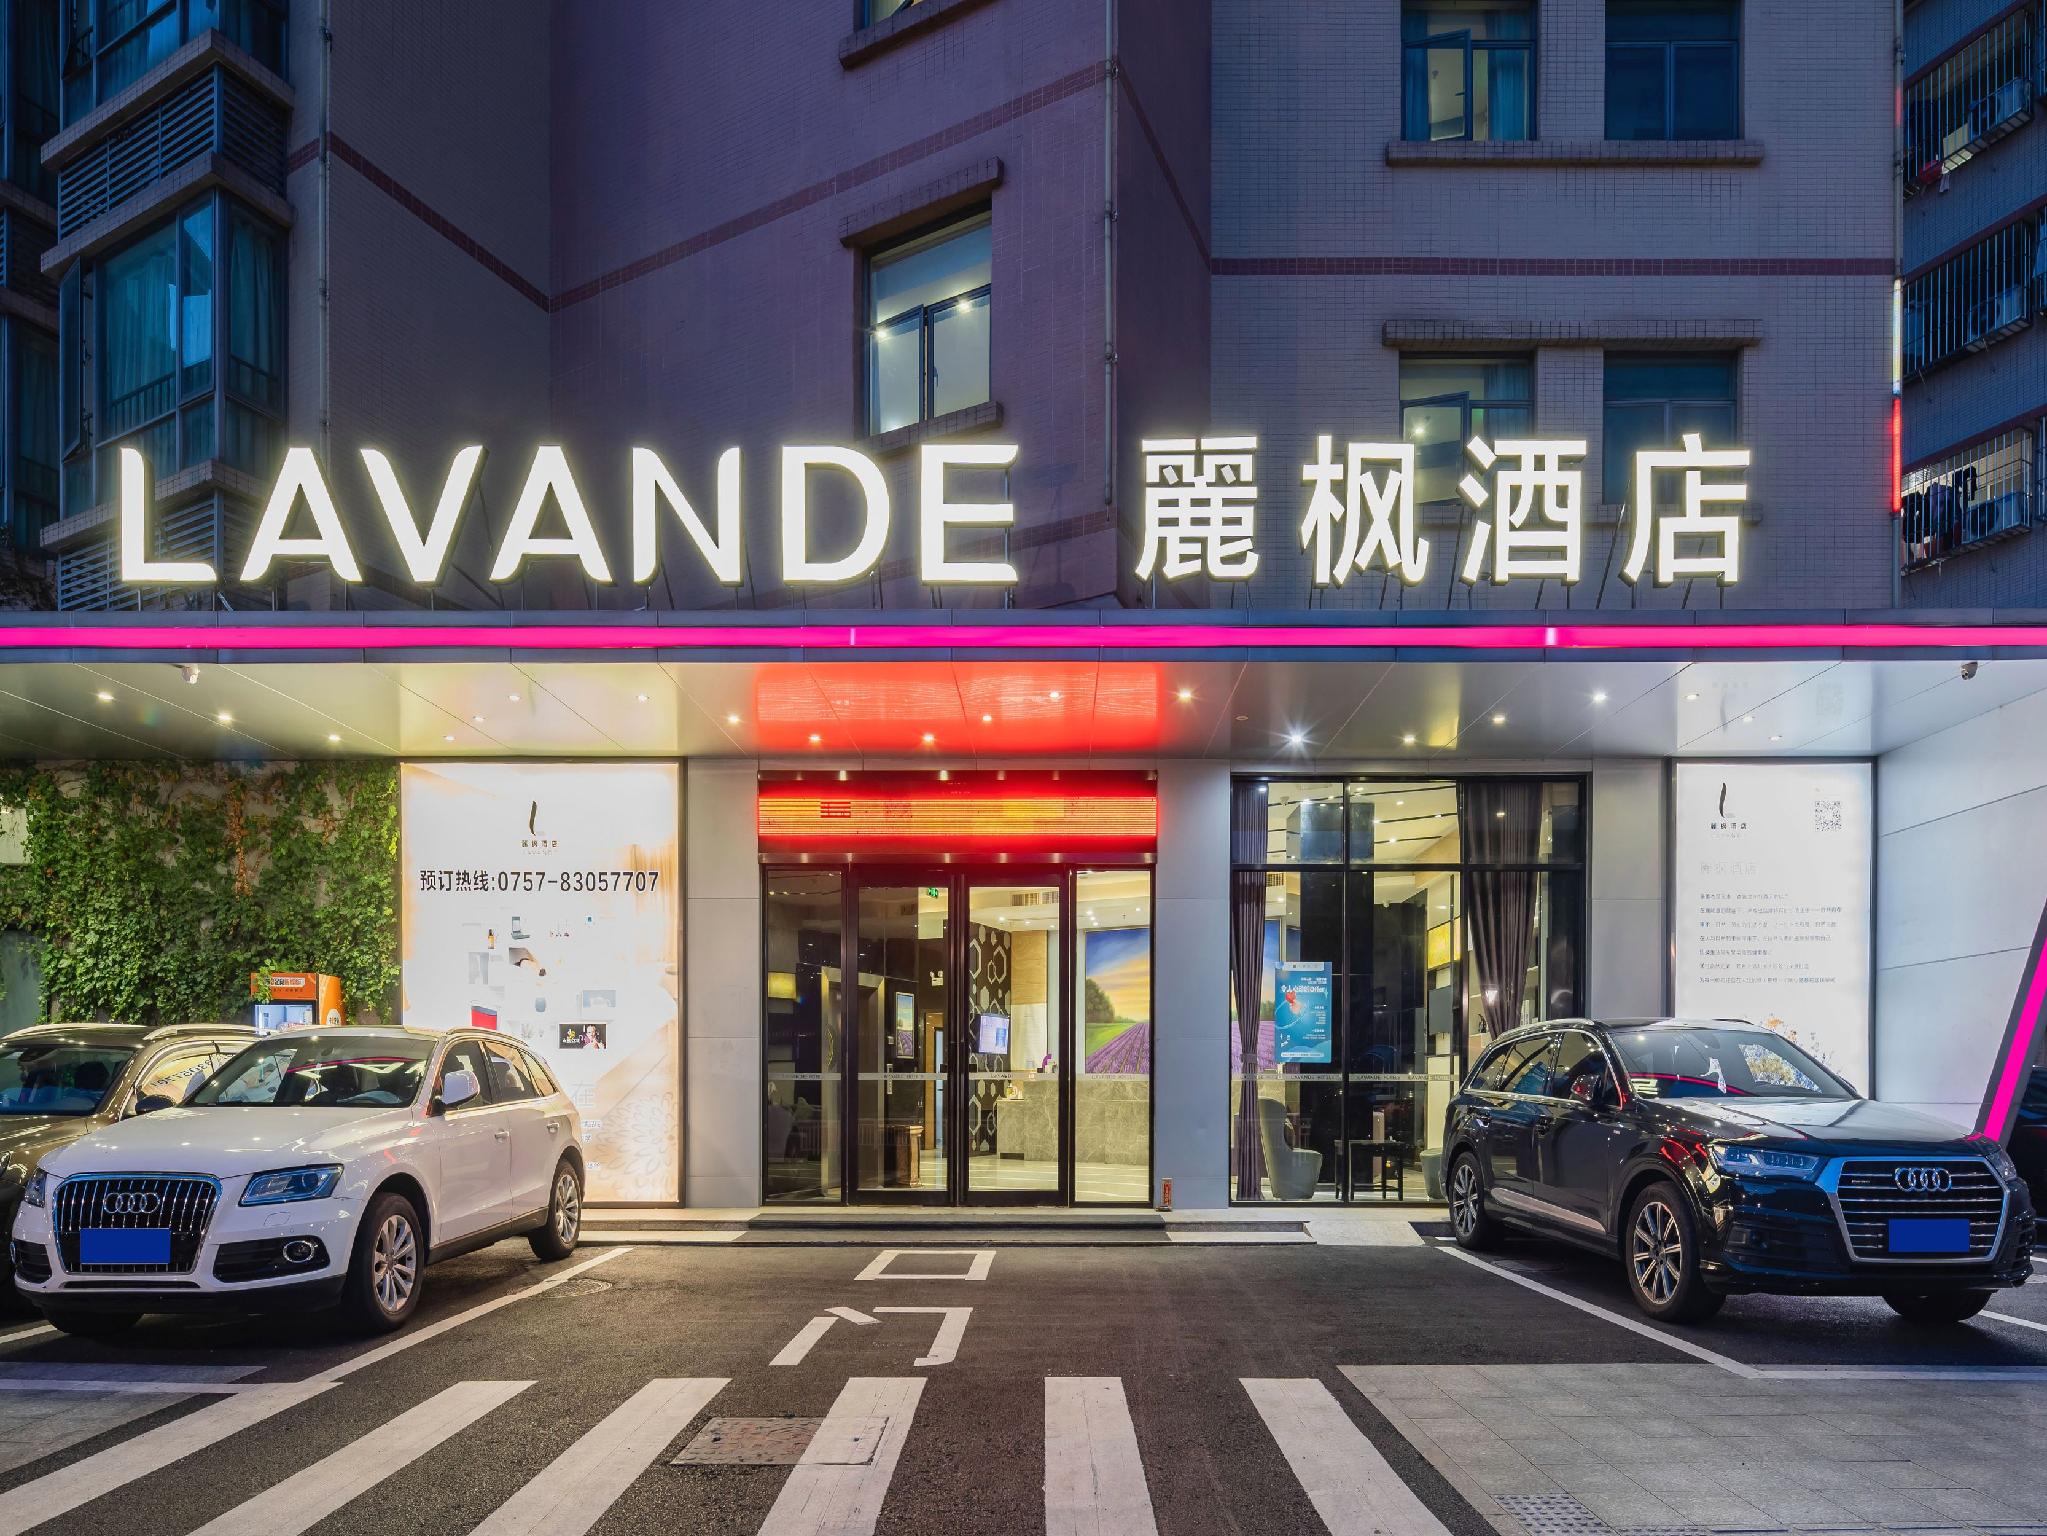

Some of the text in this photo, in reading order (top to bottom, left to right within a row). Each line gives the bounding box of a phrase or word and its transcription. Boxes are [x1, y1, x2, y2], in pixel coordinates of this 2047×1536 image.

[119, 432, 1751, 587] LAVANDE 麗枫酒店
[420, 869, 659, 892] 预订热线:0757-83057707
[768, 1306, 974, 1367] 门
